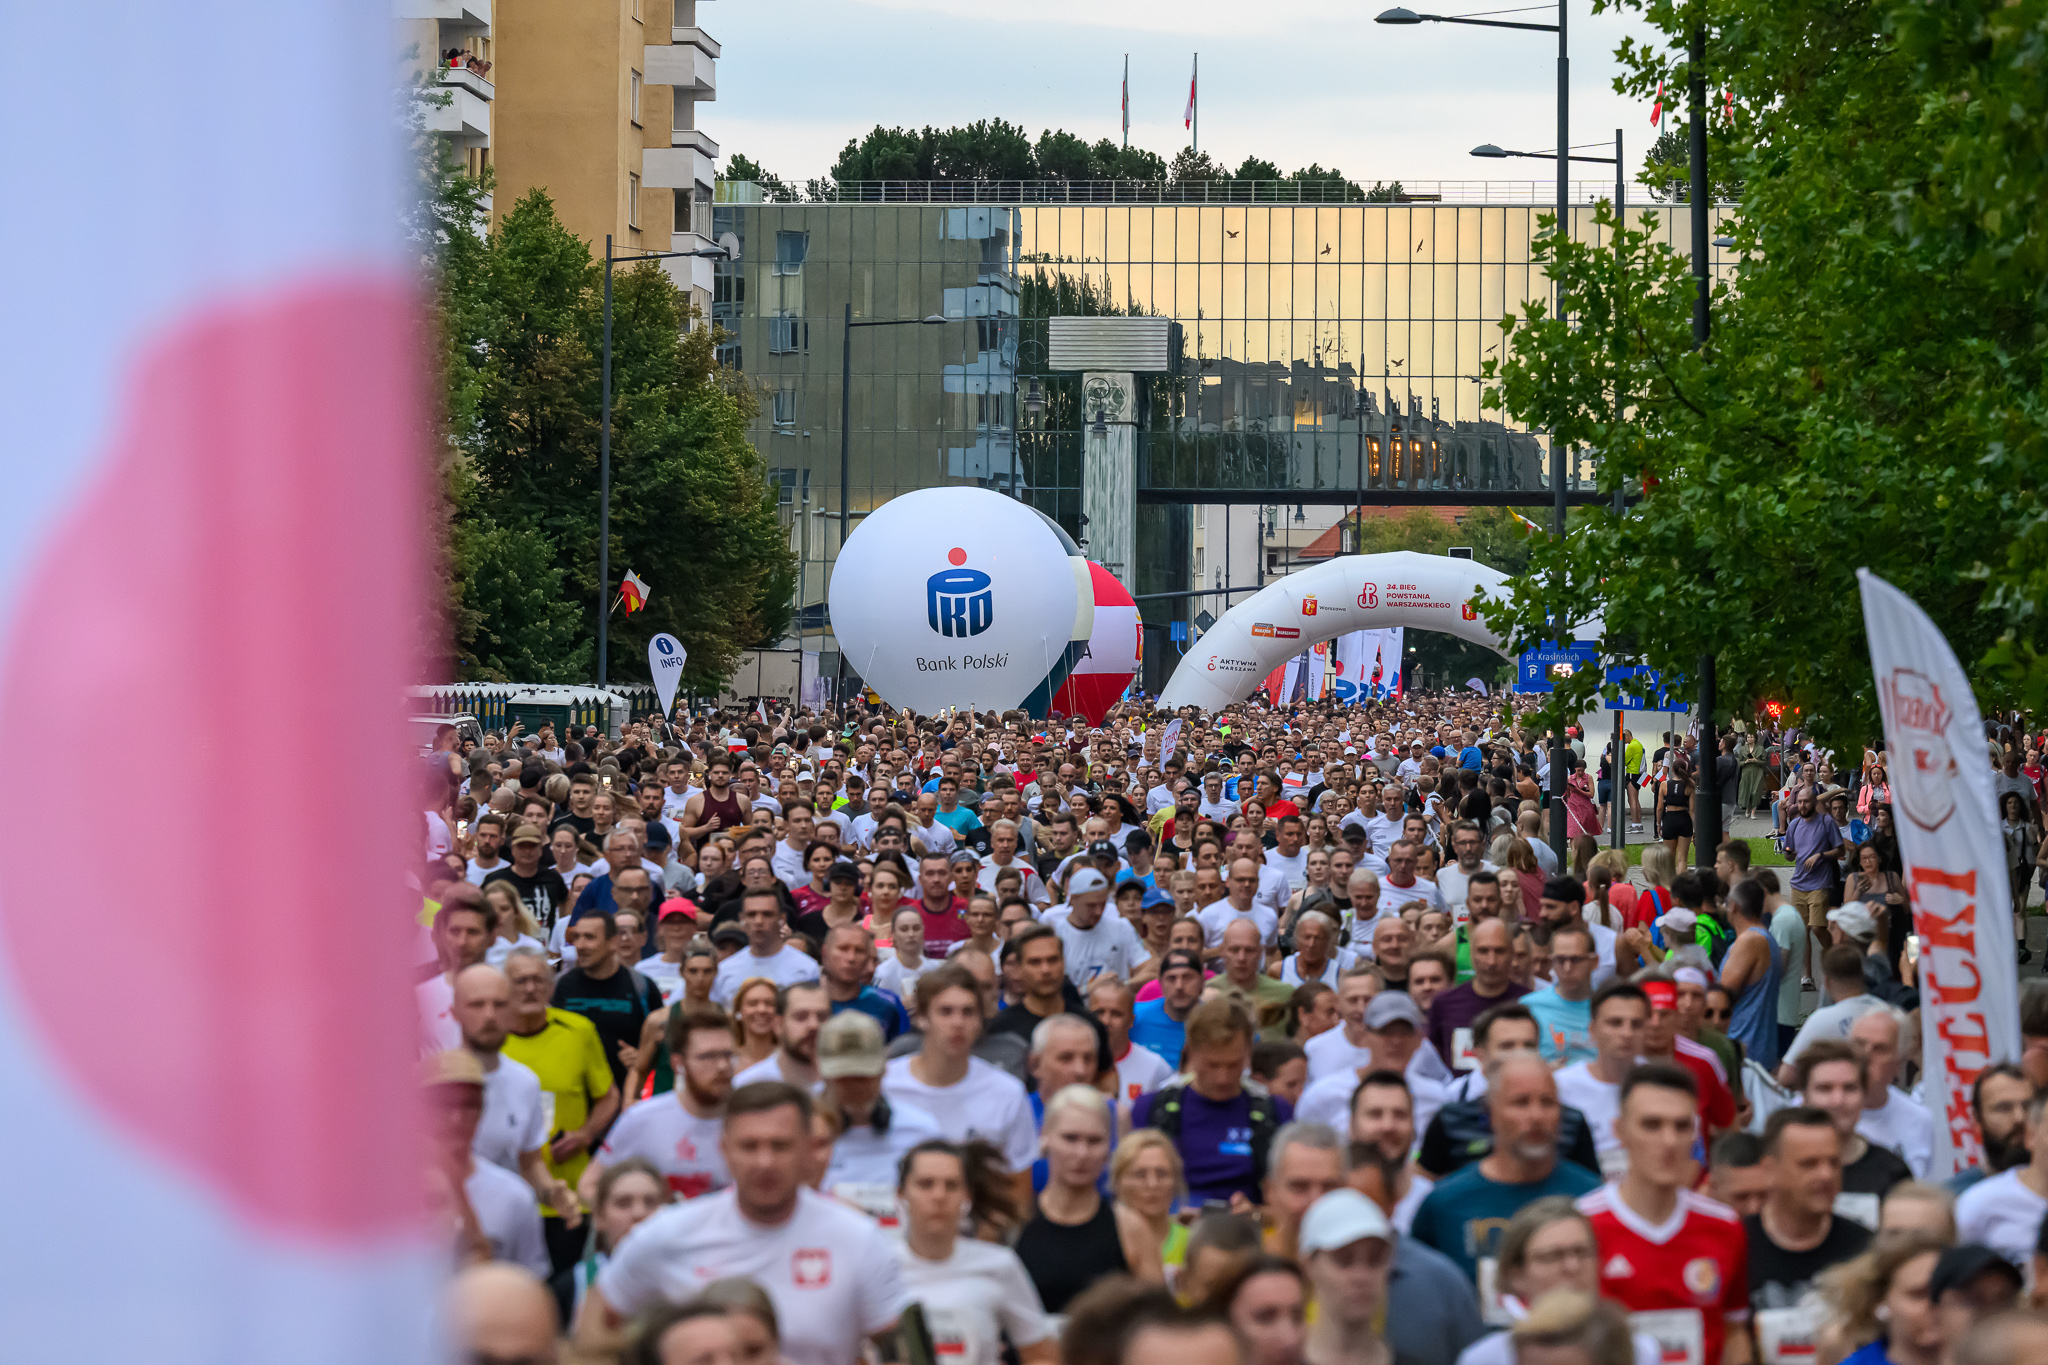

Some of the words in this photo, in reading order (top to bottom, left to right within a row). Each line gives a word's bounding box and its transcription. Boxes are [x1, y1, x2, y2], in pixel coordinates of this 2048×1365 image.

[1386, 601, 1451, 609] WARSZAWSKIEGO
[916, 655, 957, 672] Bank
[963, 652, 1009, 670] Polski
[1526, 652, 1536, 662] pl.
[1538, 652, 1580, 661] Krasińskich
[660, 656, 684, 670] INFO
[1220, 658, 1257, 667] AKTYWNA
